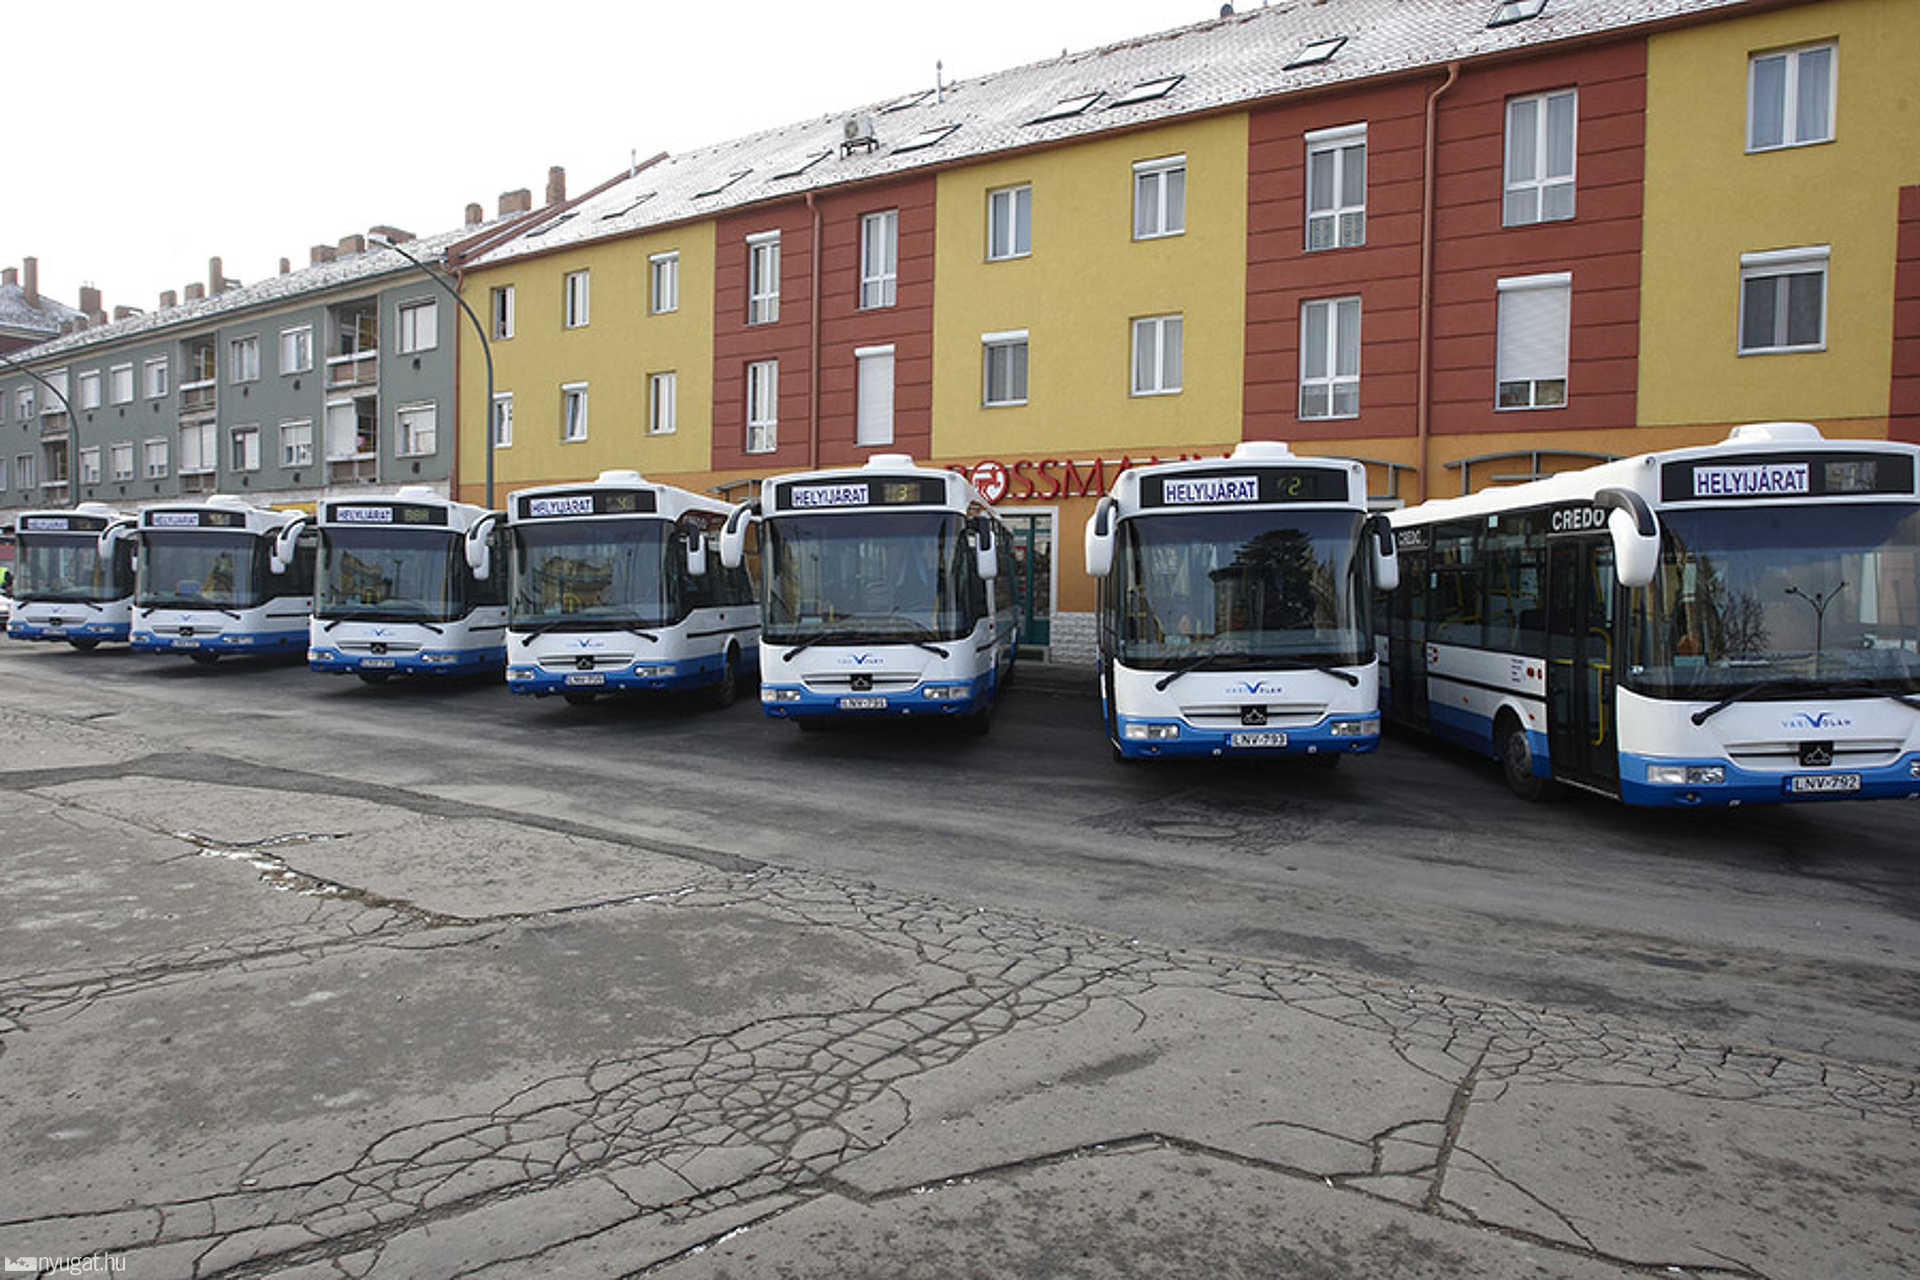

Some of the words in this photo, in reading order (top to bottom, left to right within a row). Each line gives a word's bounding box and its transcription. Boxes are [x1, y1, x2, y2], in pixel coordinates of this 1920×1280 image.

[944, 454, 1232, 504] OSSM
[1696, 466, 1807, 494] HELYIJÁRAT
[1552, 507, 1606, 531] CREDO
[1794, 775, 1859, 791] LNV-792
